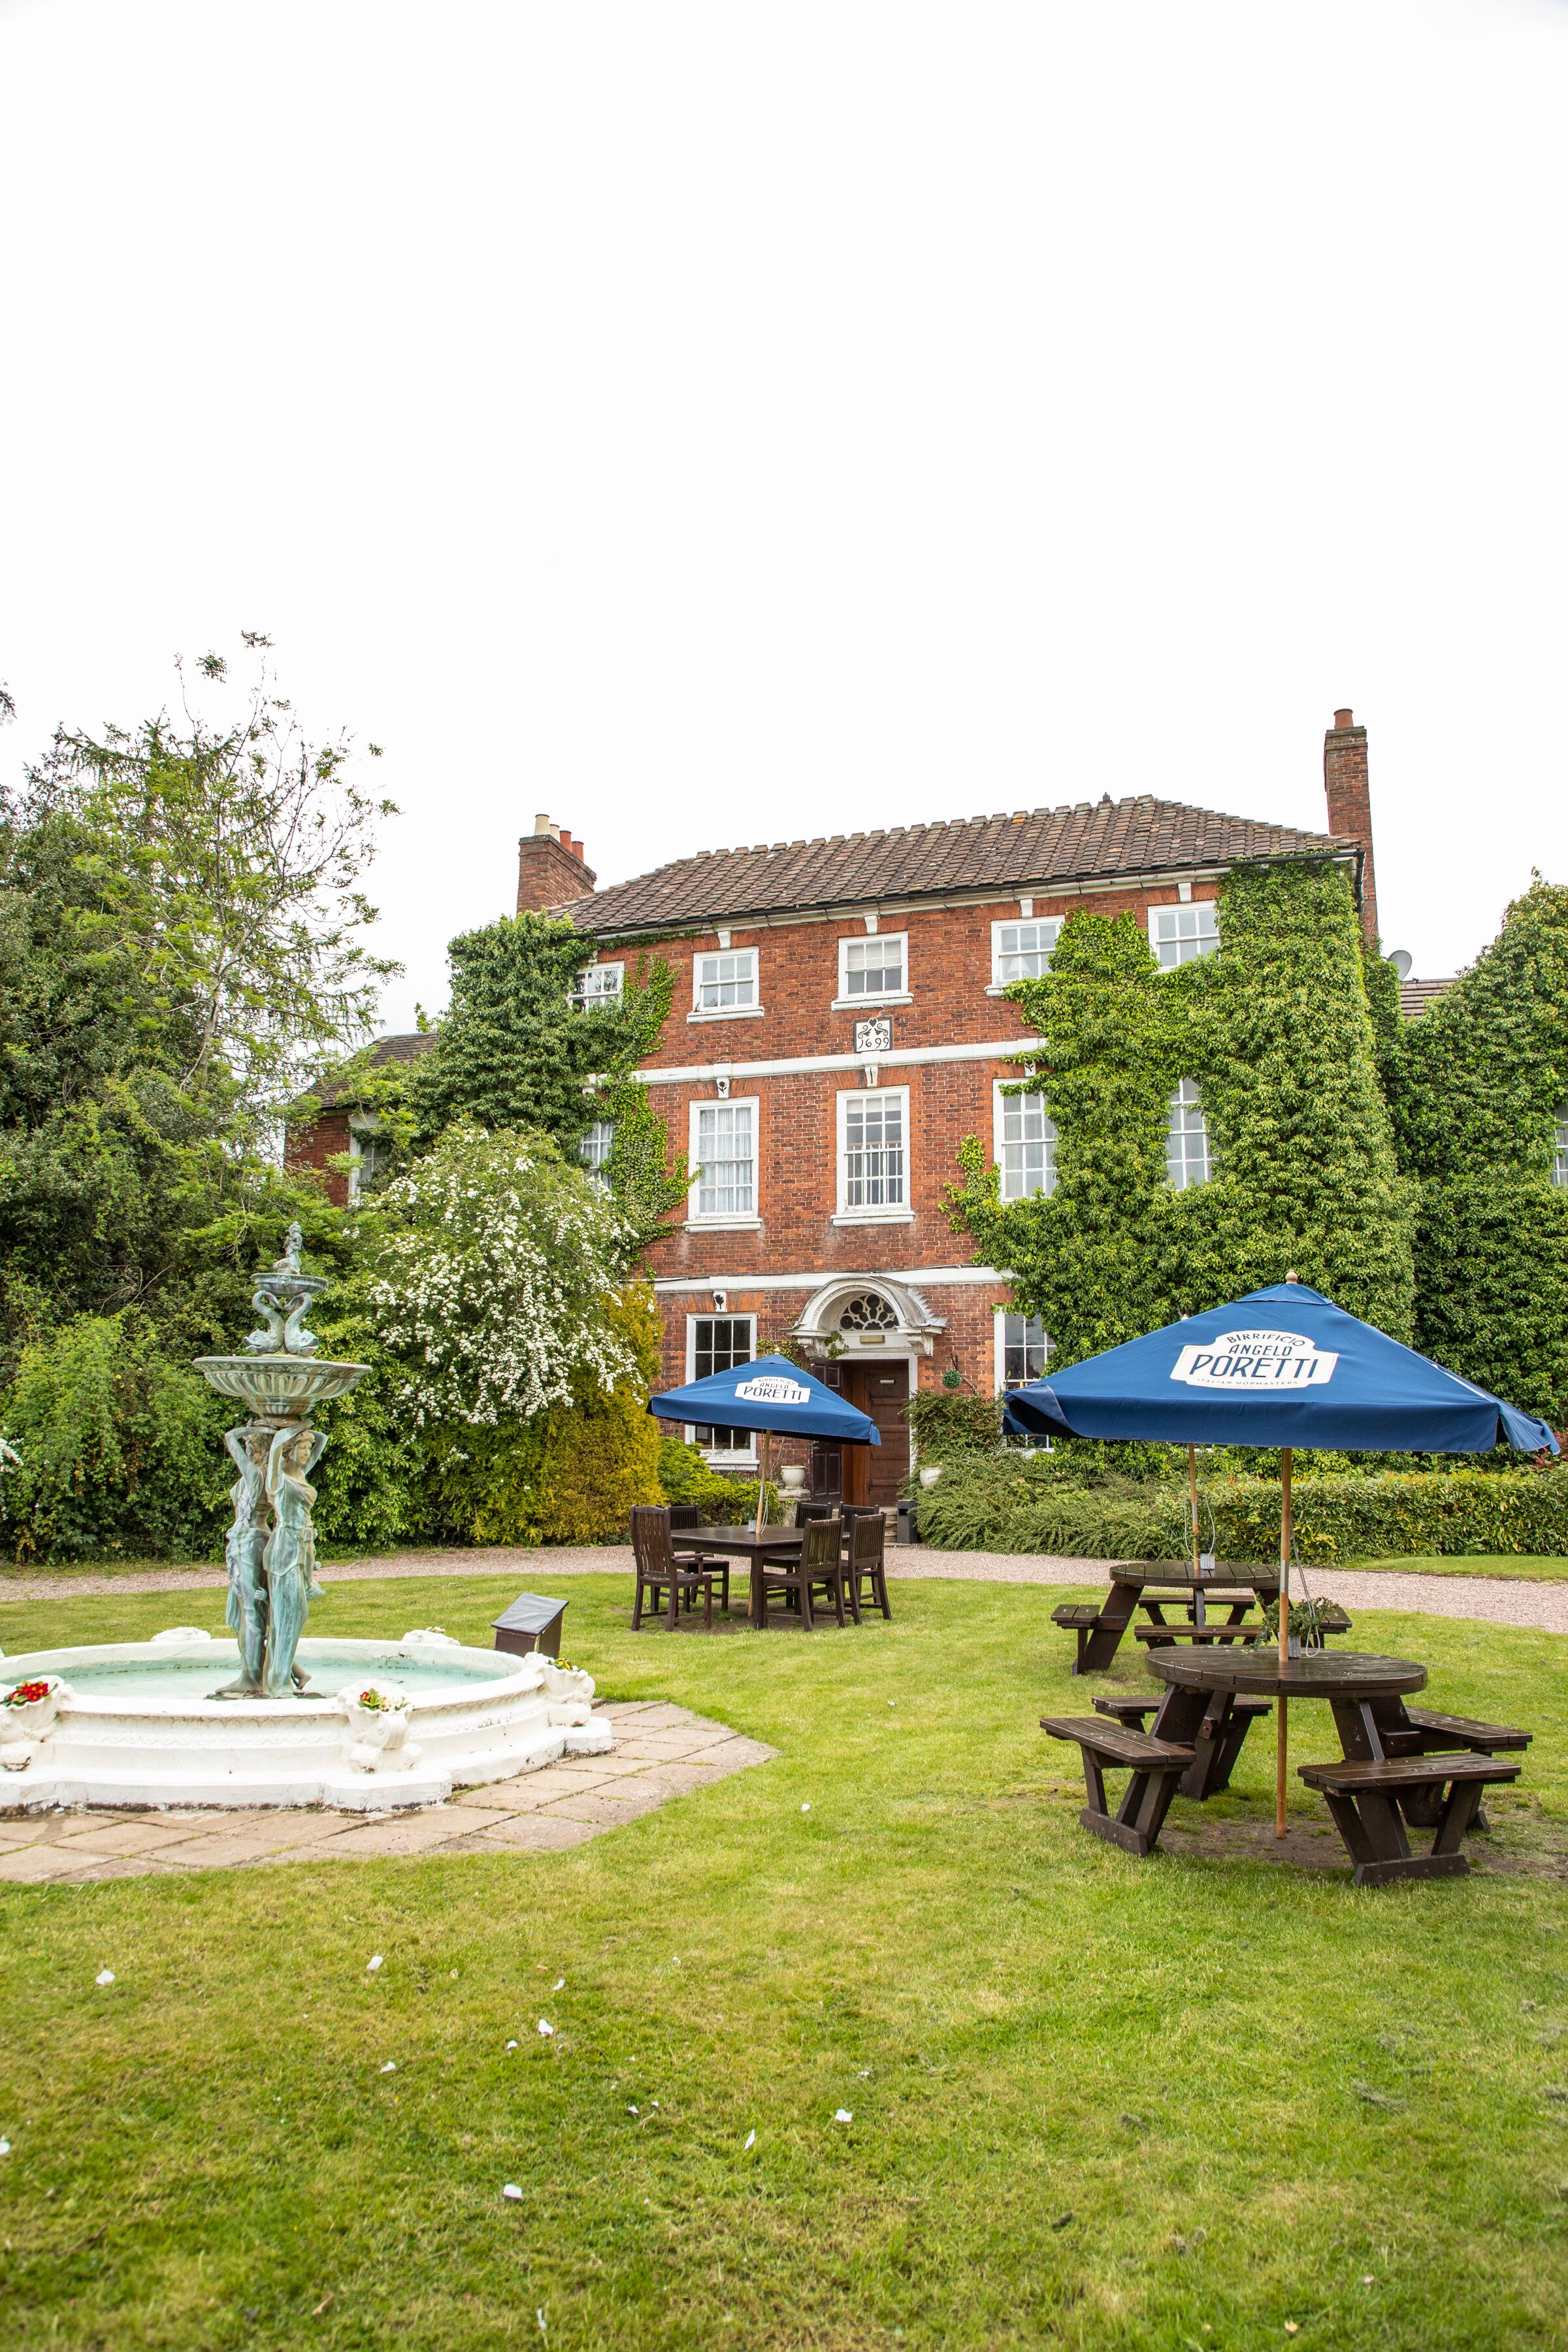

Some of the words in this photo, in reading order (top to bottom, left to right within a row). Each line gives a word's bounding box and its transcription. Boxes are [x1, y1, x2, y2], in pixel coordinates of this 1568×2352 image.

[858, 1037, 889, 1049] 1699
[1227, 1333, 1305, 1347] BIRRIFICIO
[1228, 1344, 1292, 1356] ANGELO
[1189, 1354, 1318, 1379] PORETTI
[743, 1386, 802, 1400] PORETTI
